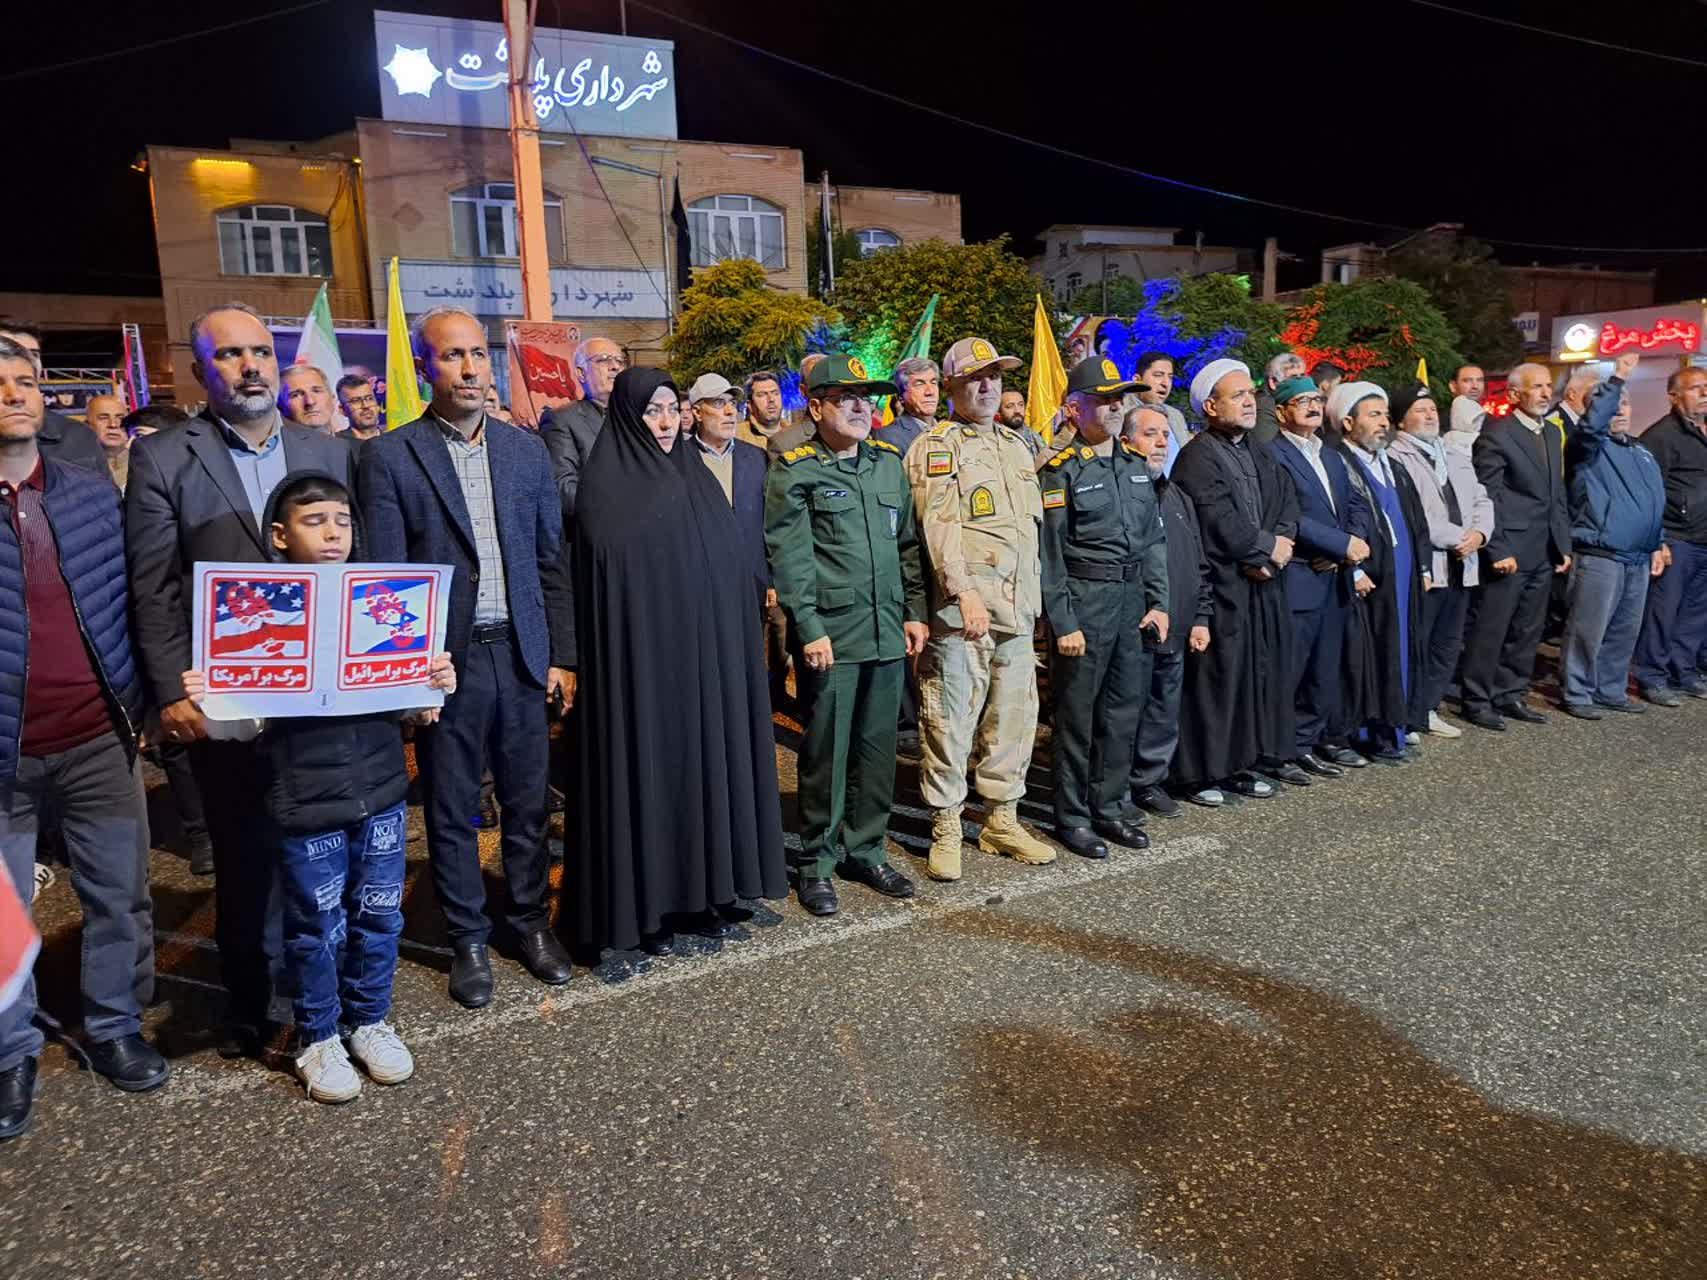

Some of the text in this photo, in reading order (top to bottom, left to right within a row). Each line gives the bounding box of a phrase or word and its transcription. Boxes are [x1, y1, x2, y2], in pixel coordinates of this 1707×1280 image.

[553, 50, 668, 112] شهرداری
[423, 277, 633, 310] شهردار پلدشت
[212, 667, 304, 686] مرگ بر آمریکا
[388, 666, 402, 681] بر
[402, 661, 427, 677] مرگ
[307, 835, 341, 856] MIND
